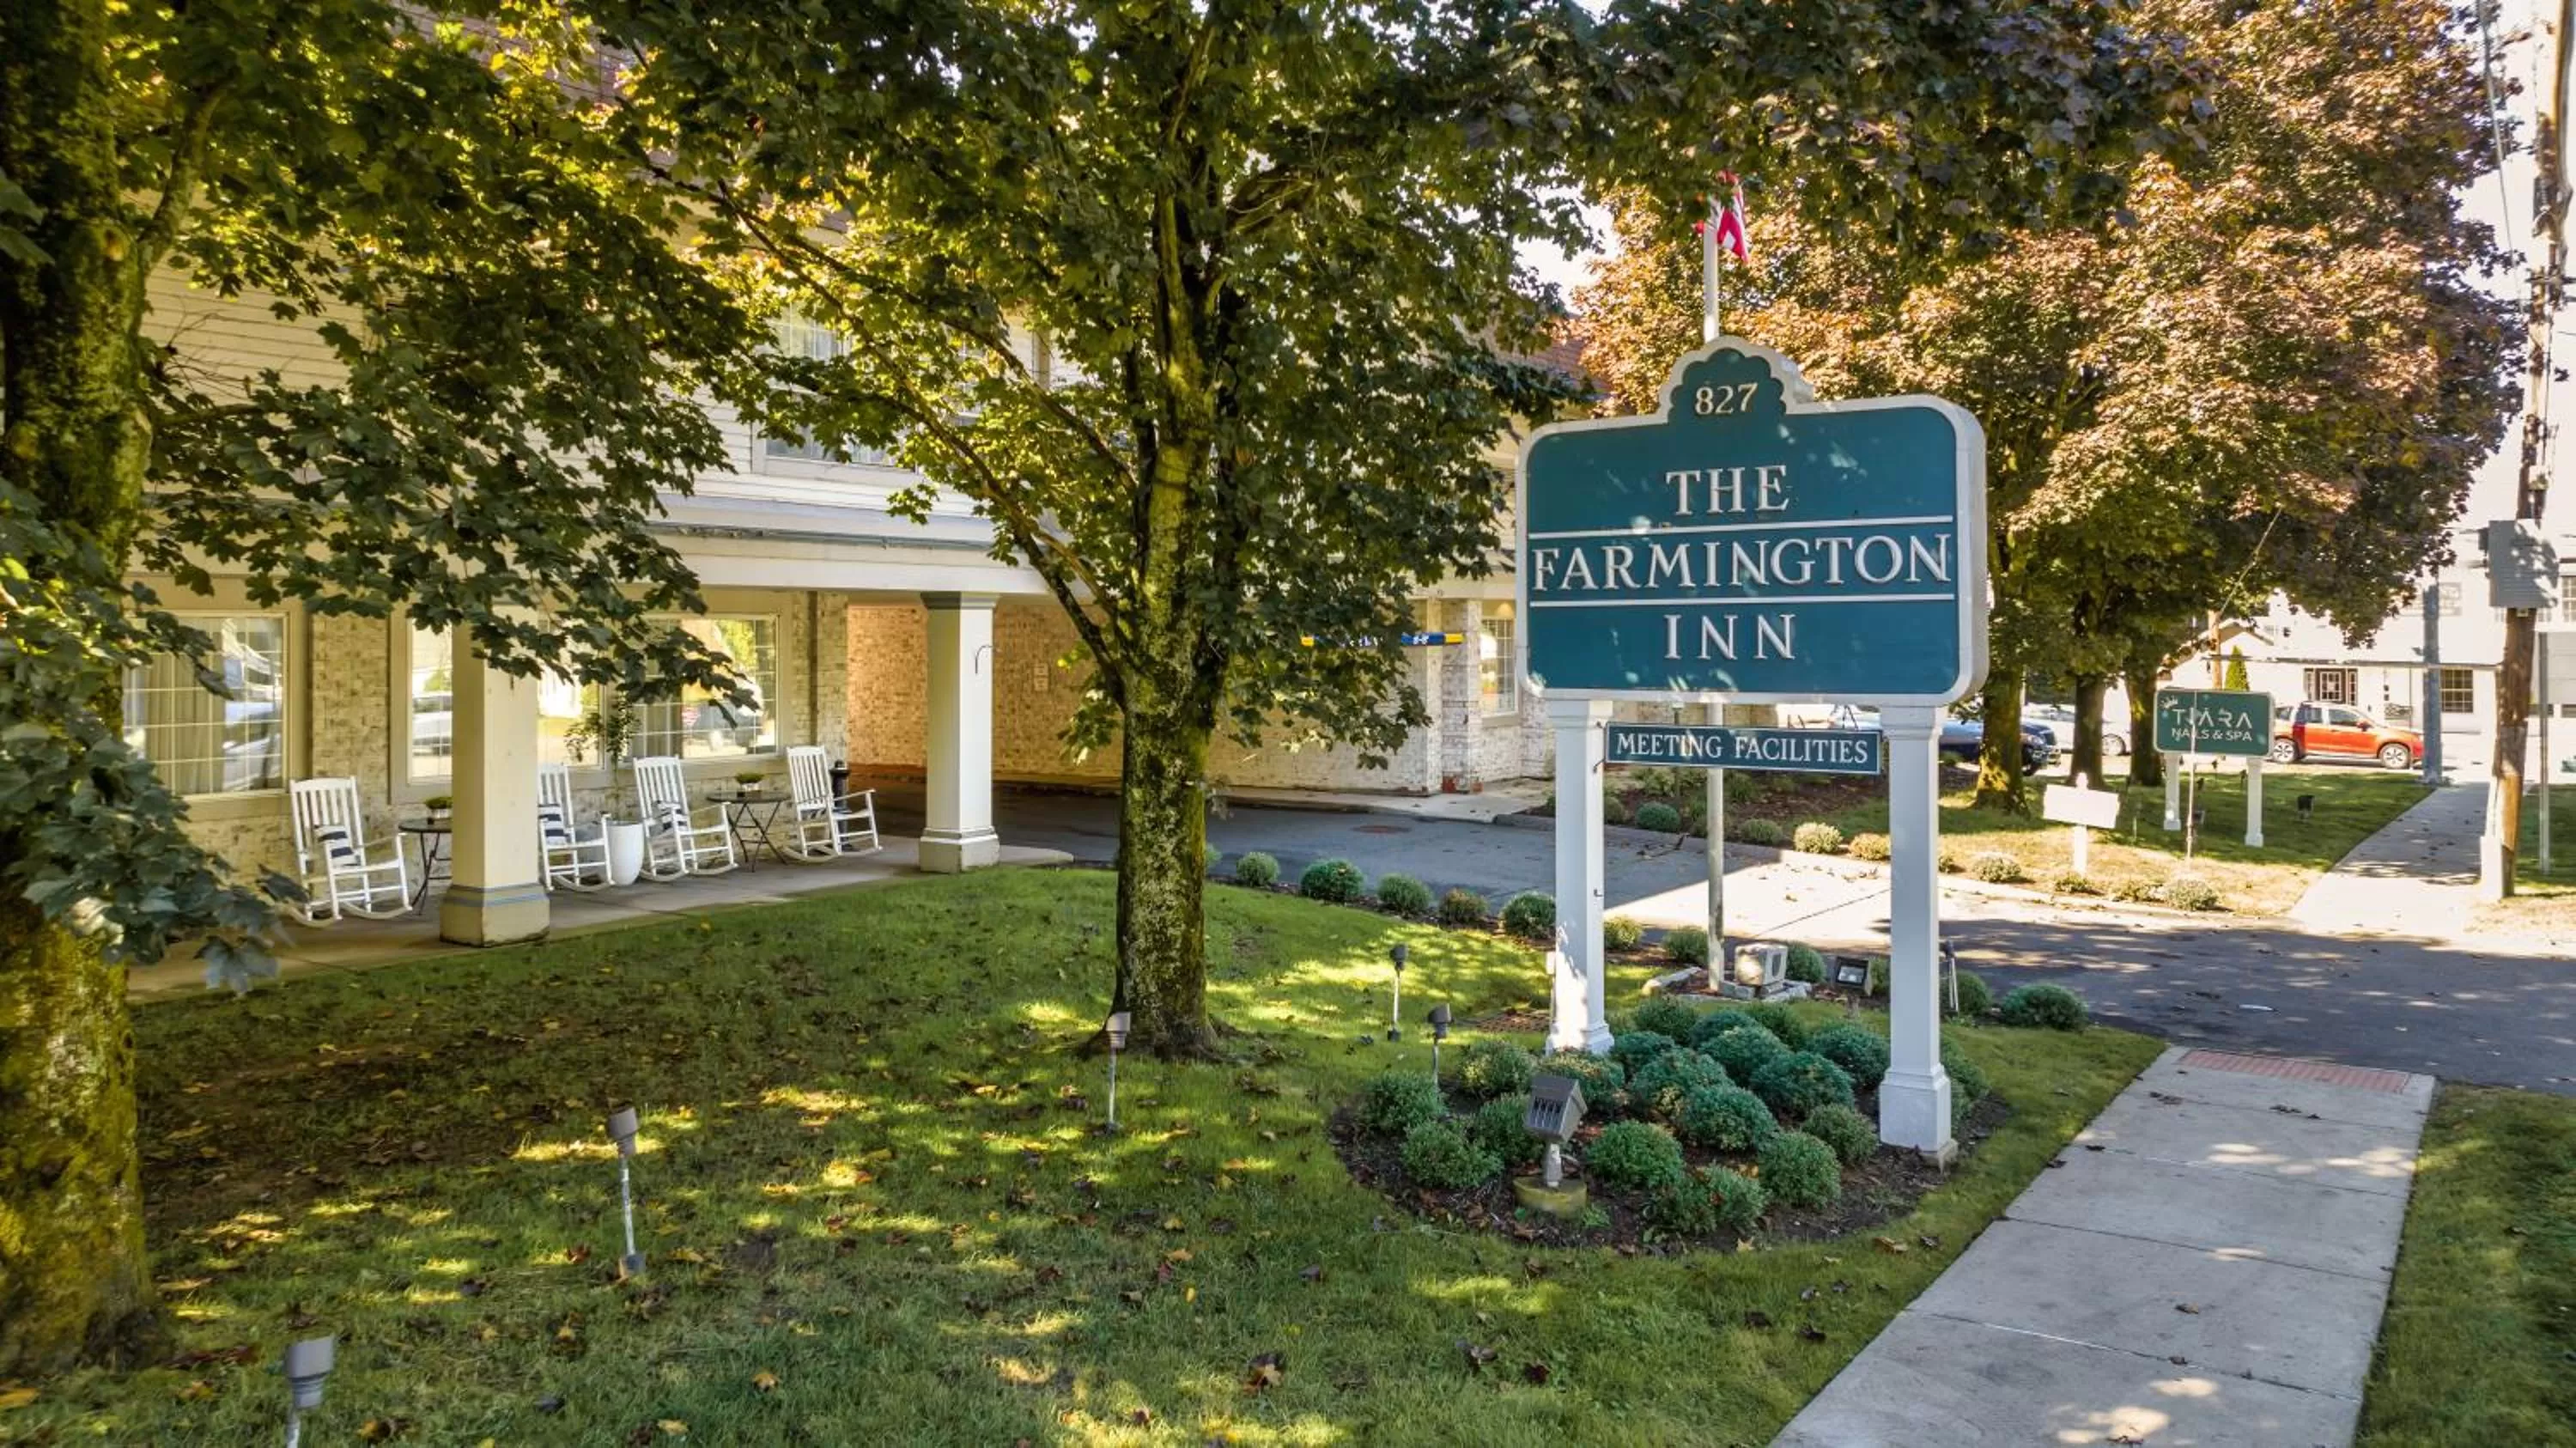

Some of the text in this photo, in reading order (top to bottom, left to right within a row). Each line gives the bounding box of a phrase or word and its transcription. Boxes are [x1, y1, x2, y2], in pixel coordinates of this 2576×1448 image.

[1695, 382, 1759, 415] 827
[1666, 465, 1790, 515] THE
[1532, 533, 1952, 592] FARMINGTON
[1663, 613, 1796, 660] INN
[2172, 707, 2252, 729] TIARA
[2172, 727, 2253, 742] NALS & SPA
[1616, 732, 1868, 764] MEETING FACILITIES
